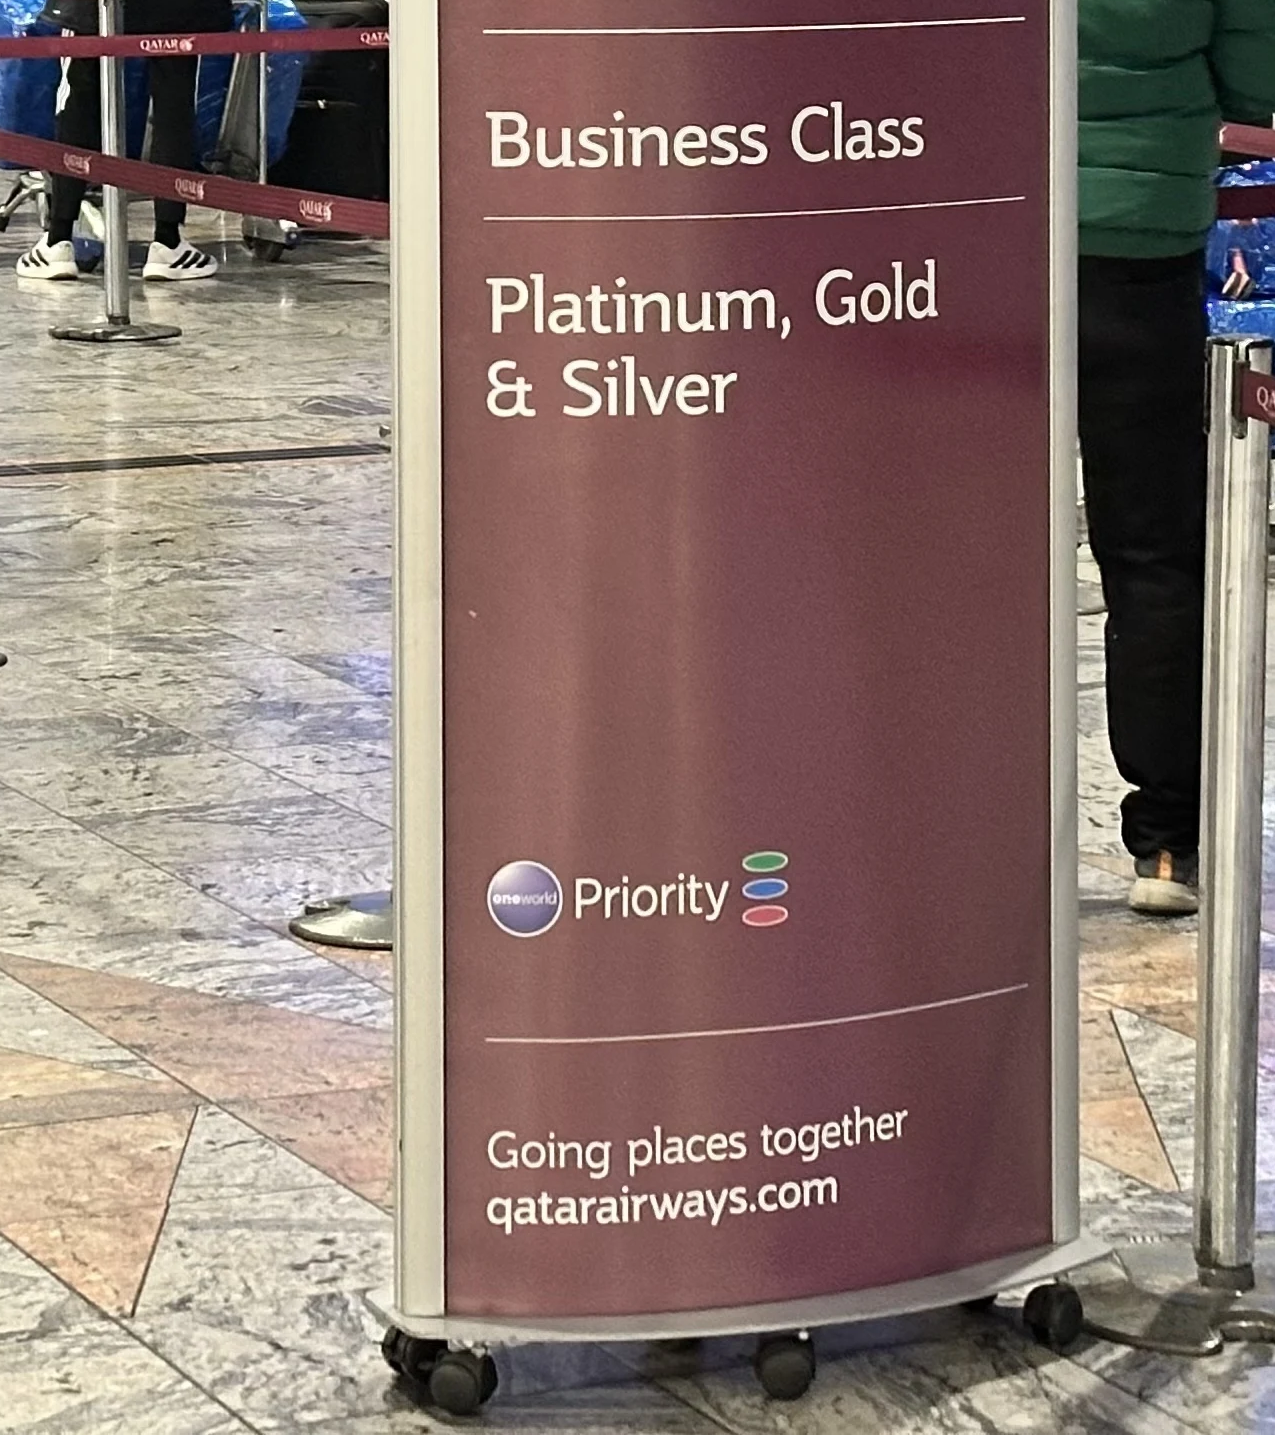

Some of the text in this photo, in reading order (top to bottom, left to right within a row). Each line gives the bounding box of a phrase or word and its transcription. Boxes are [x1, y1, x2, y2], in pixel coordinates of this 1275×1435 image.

[139, 39, 179, 52] QATAR
[485, 100, 926, 169] Business Class
[485, 258, 940, 341] Platinum, Gold
[485, 354, 739, 419] & Silver
[492, 872, 730, 922] oneworld Priority
[486, 1105, 910, 1180] Going places together
[485, 1174, 839, 1236] qatarairways.com
